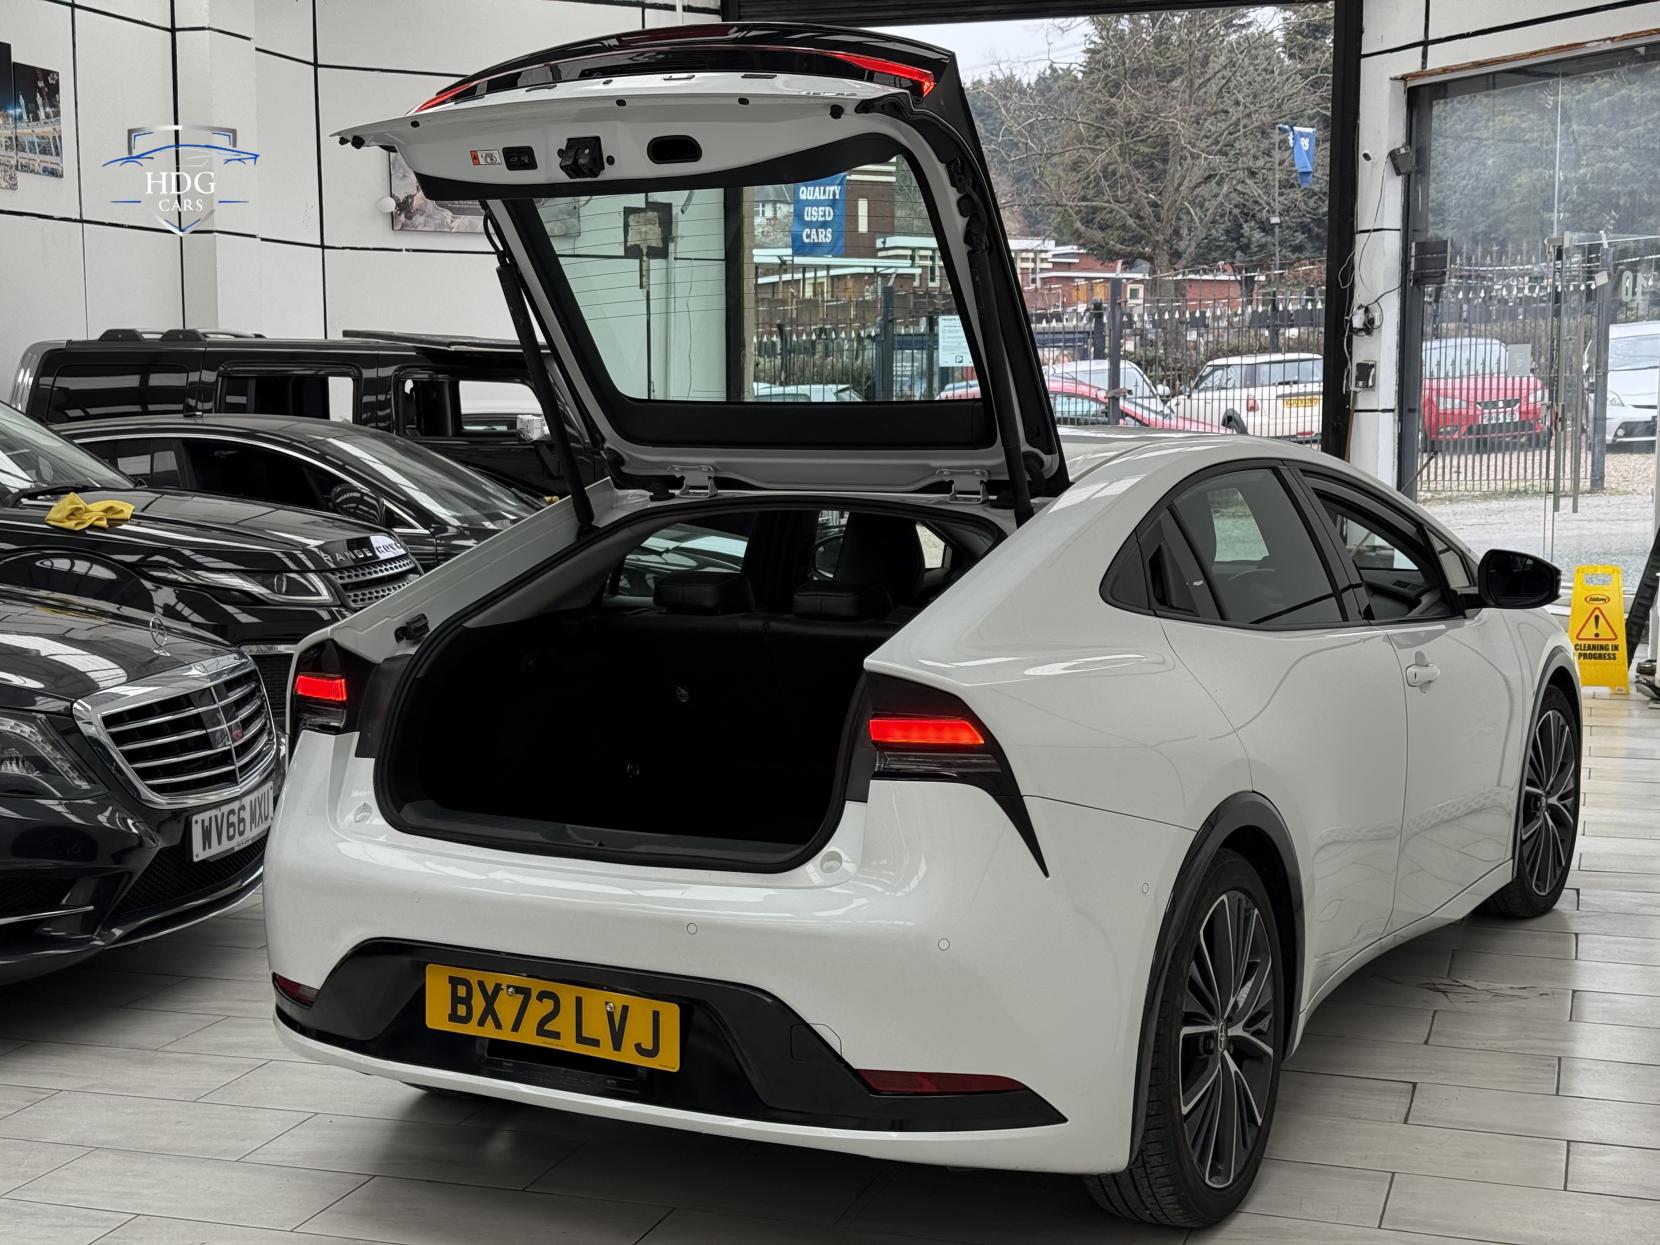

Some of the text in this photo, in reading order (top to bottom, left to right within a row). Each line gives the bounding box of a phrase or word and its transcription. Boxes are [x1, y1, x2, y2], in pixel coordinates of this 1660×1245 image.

[799, 186, 841, 200] QUALITY
[804, 206, 834, 221] USED
[802, 228, 832, 243] CARS
[321, 548, 373, 562] RANGE
[1574, 643, 1609, 651] CLEANING
[201, 789, 270, 851] WV66 MXU
[447, 975, 660, 1059] BX72 LVJ
